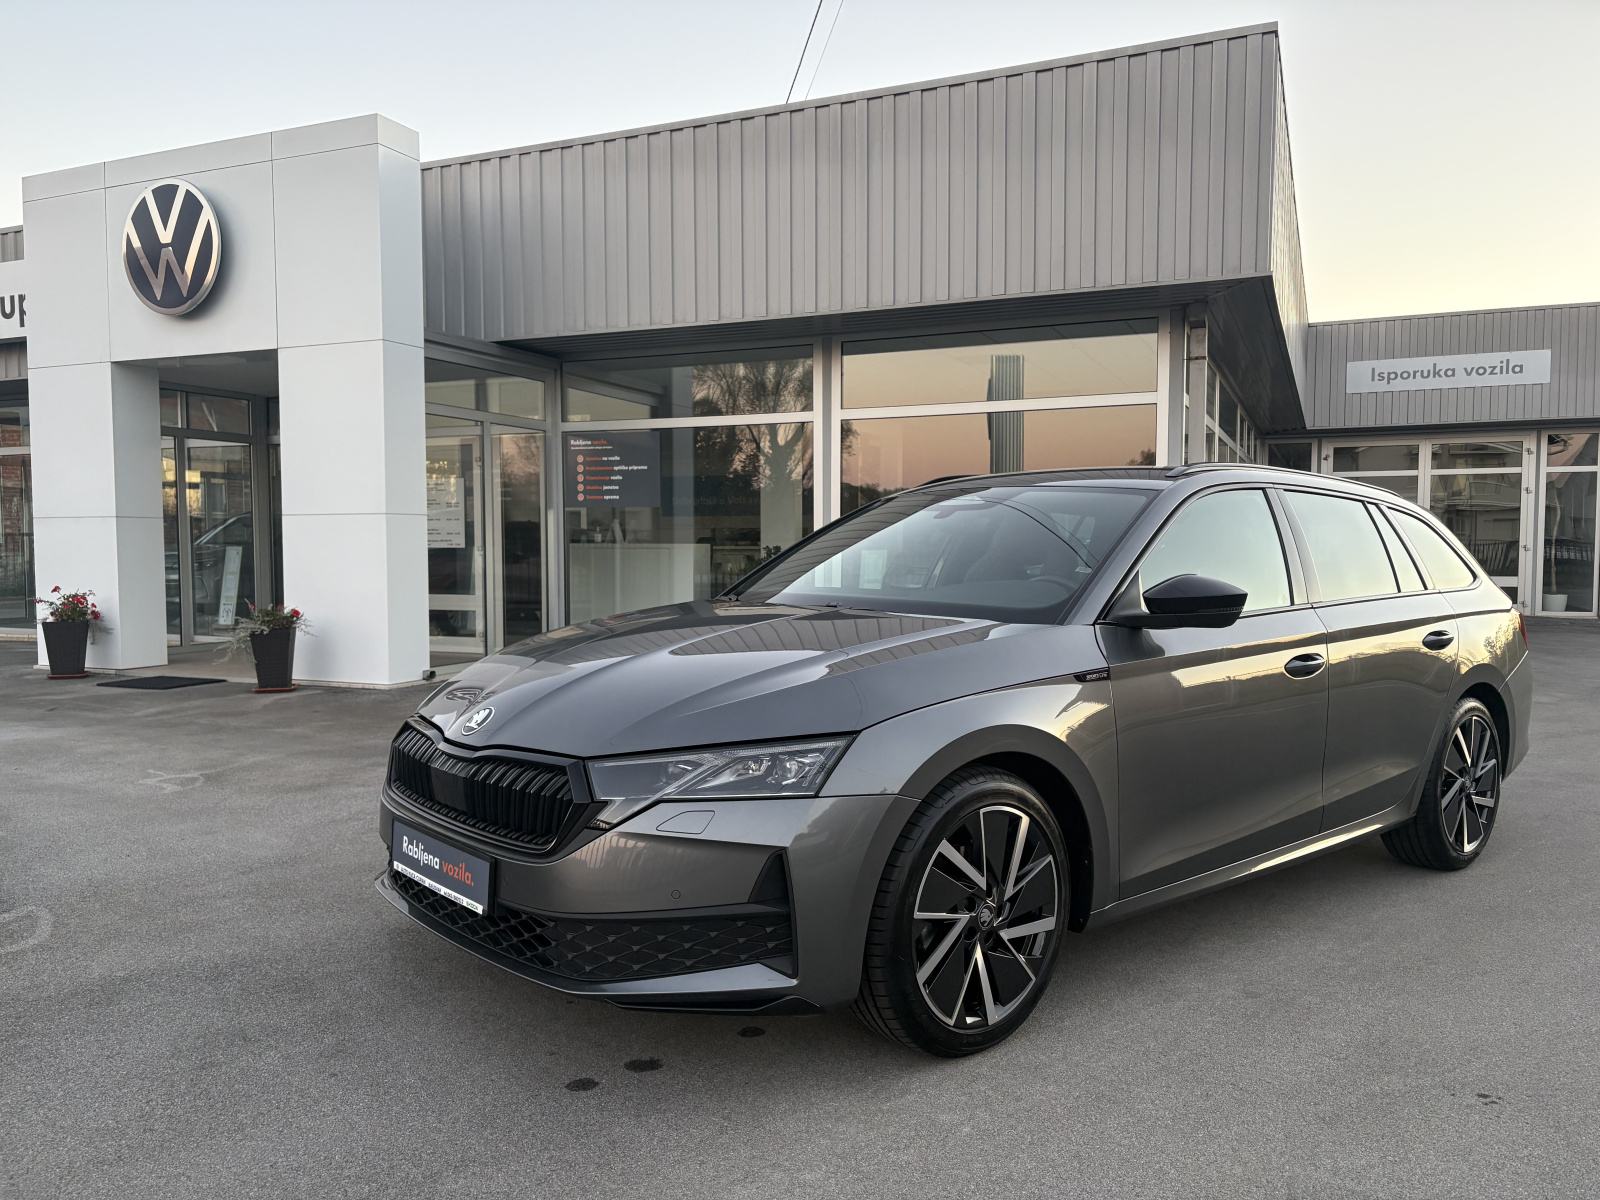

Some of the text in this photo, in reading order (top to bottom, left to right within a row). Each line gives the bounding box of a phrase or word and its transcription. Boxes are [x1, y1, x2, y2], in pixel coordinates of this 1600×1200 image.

[1370, 358, 1524, 385] Isporuka vozila
[402, 835, 440, 870] Rabljena
[441, 860, 474, 887] vozila.
